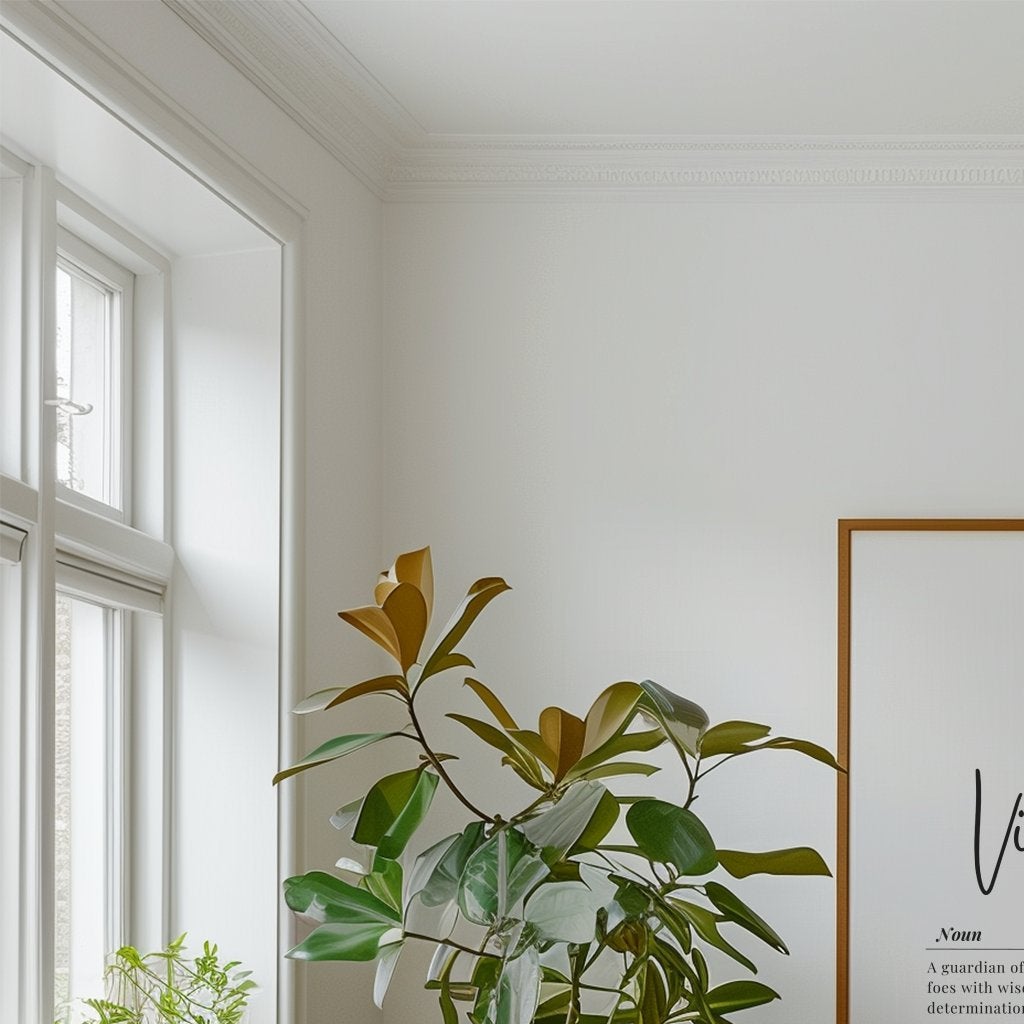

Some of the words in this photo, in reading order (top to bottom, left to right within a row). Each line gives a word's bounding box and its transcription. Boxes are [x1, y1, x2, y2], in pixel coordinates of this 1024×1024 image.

[936, 927, 982, 943] Noun
[927, 961, 937, 974] A
[941, 961, 1005, 976] guardian
[927, 981, 957, 994] foes
[961, 981, 993, 994] with
